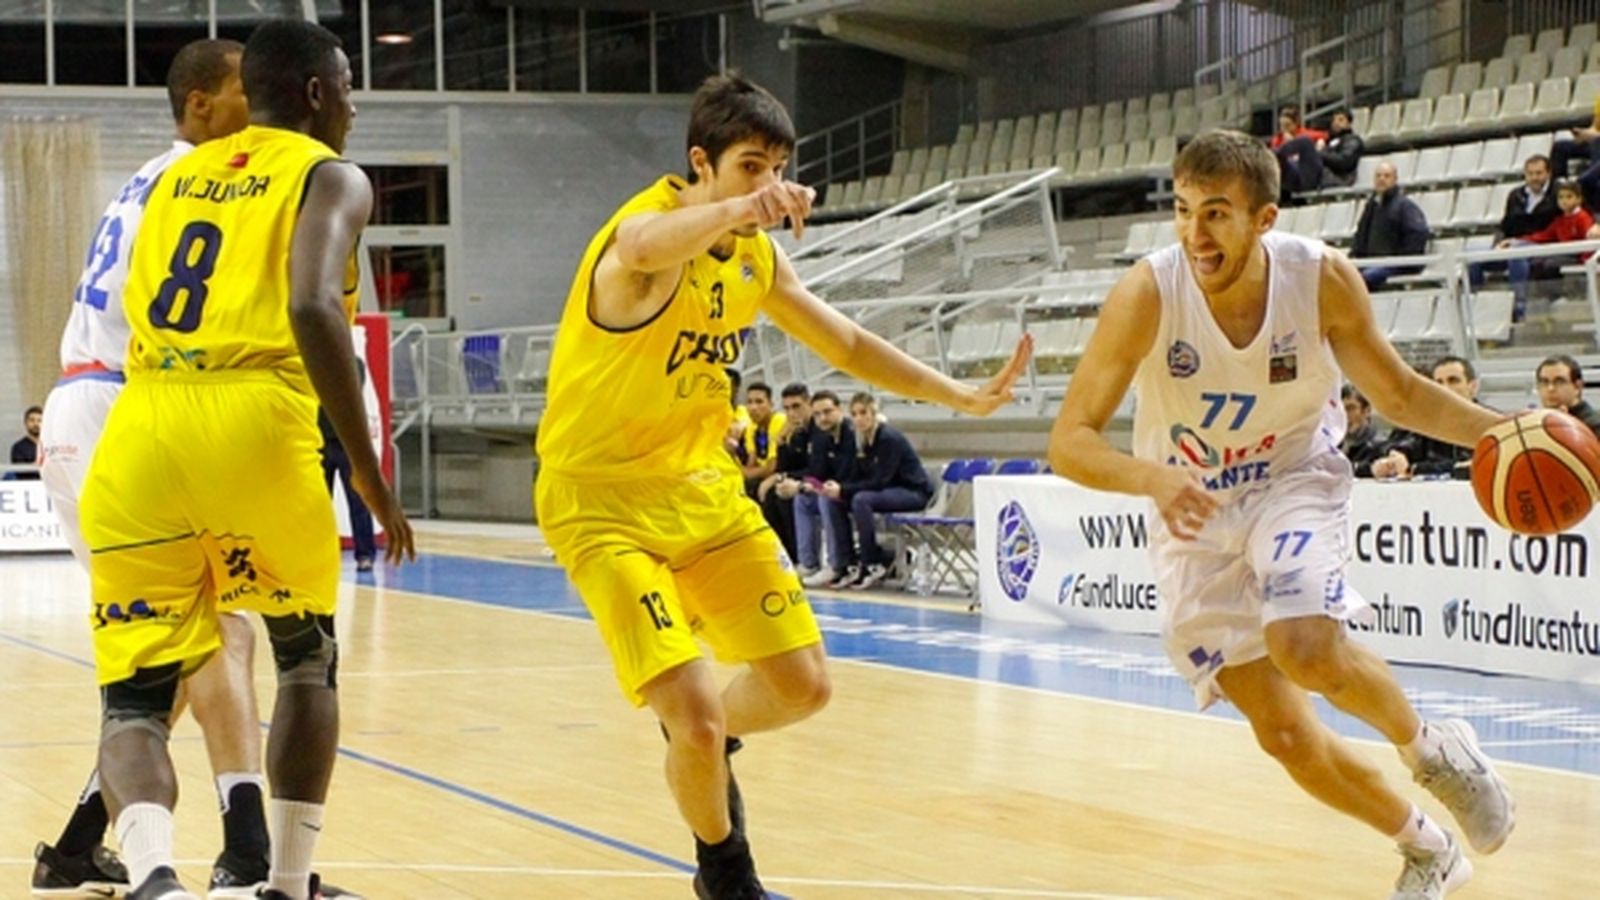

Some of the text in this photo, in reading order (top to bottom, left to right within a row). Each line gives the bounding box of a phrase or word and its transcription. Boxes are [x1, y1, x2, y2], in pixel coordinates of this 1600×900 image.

[75, 215, 123, 311] 12
[148, 220, 223, 333] 8
[1200, 392, 1258, 431] 77
[1271, 530, 1313, 562] 77
[1355, 510, 1589, 578] centum.com
[639, 590, 674, 631] 13
